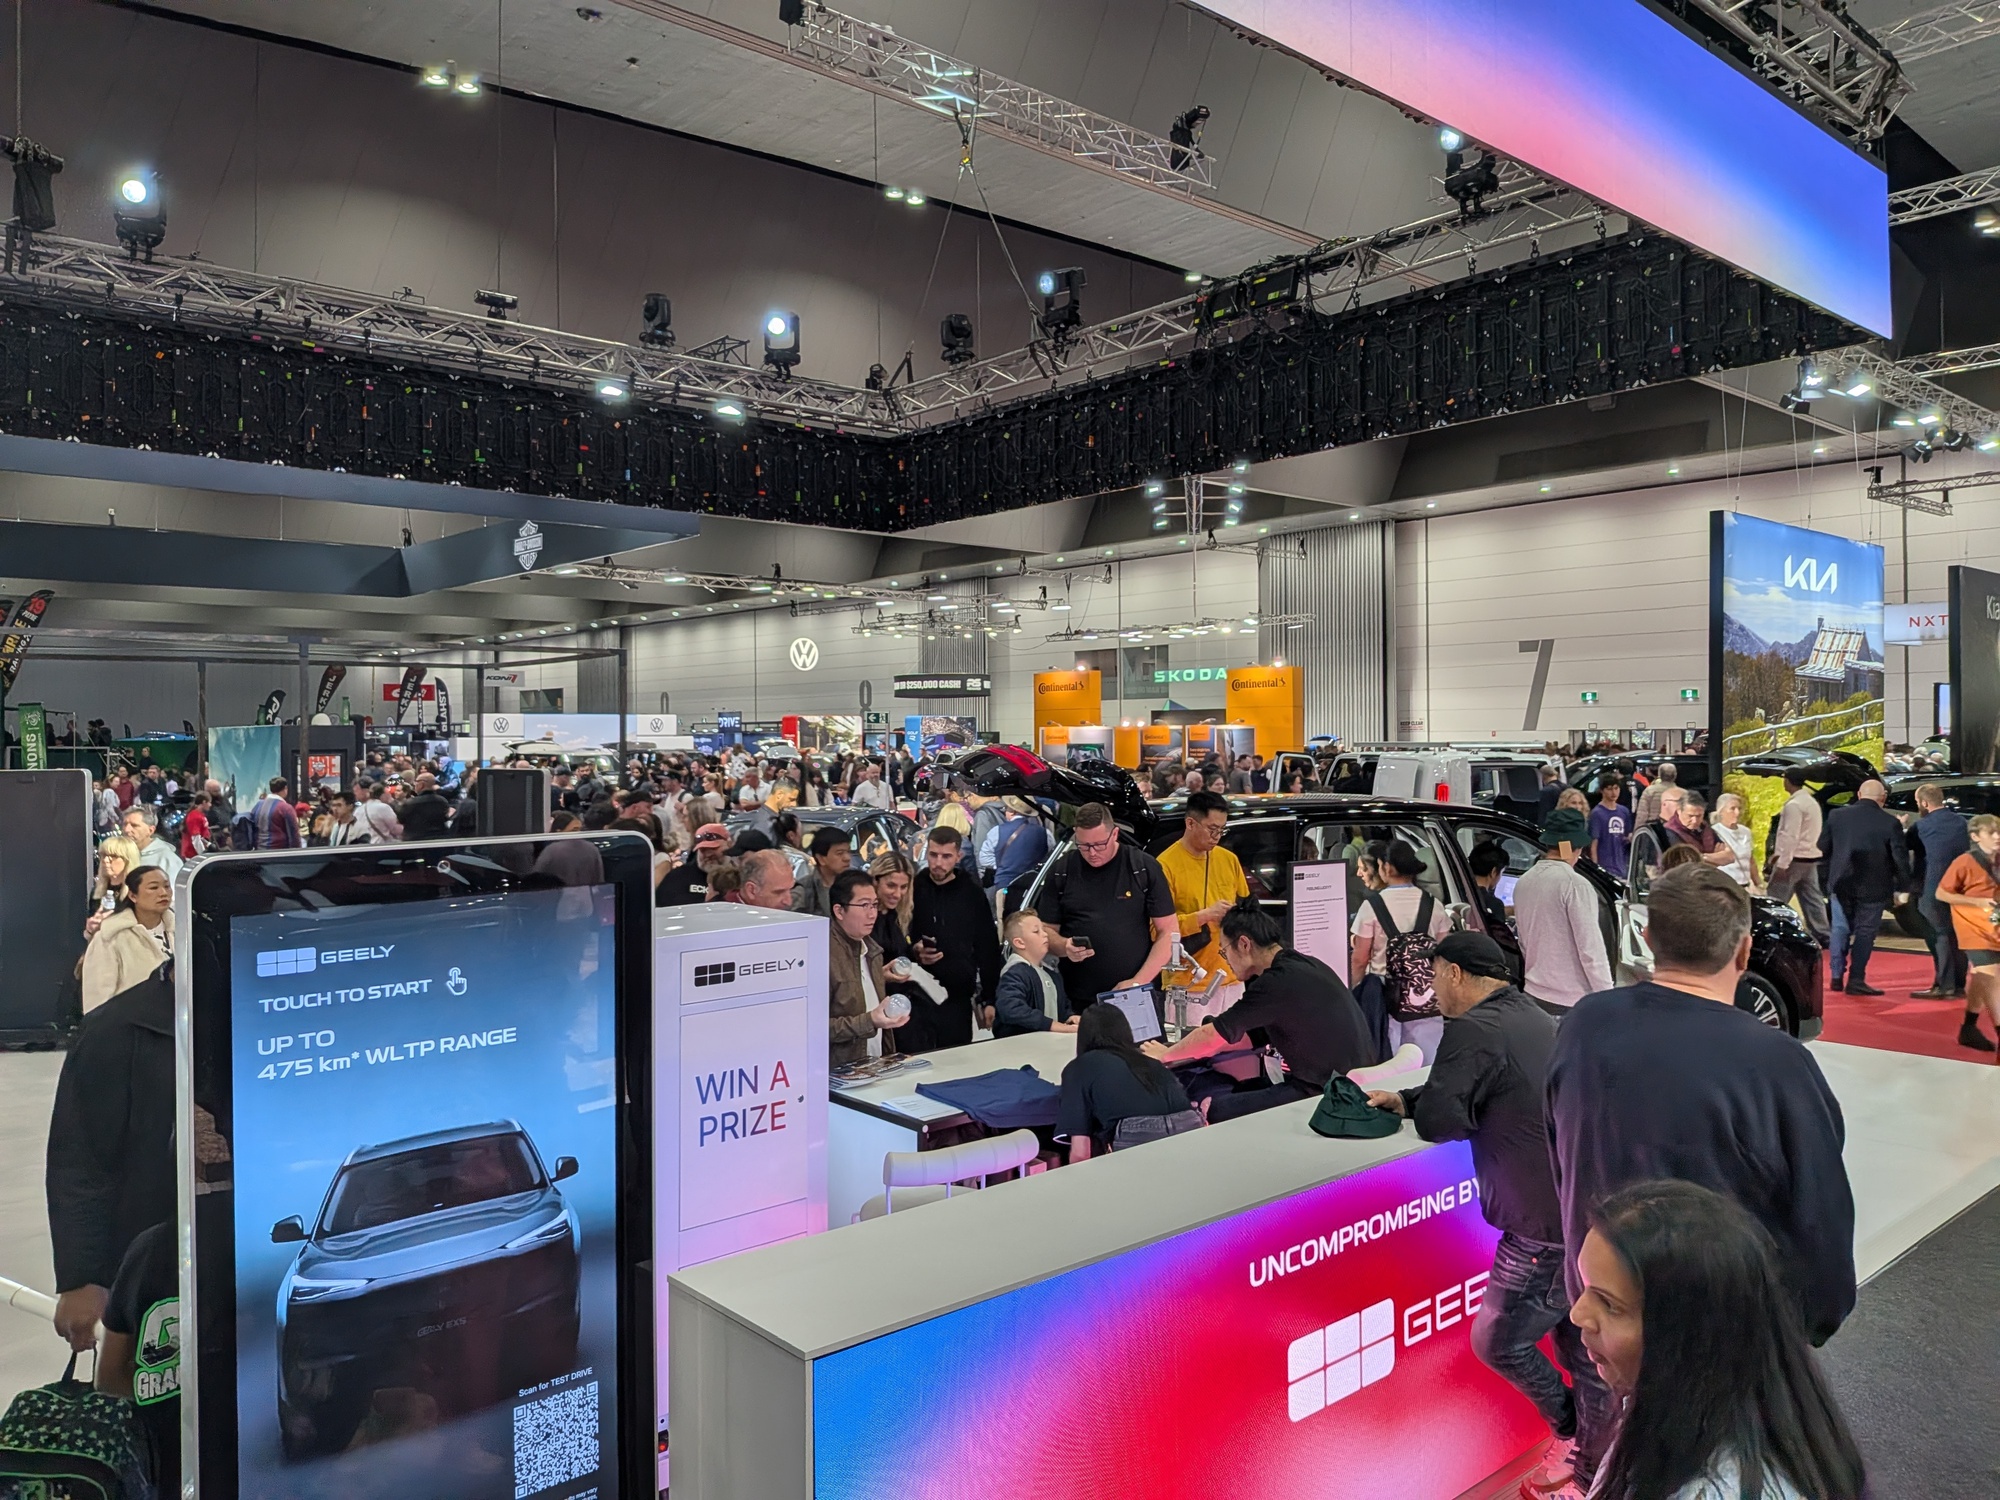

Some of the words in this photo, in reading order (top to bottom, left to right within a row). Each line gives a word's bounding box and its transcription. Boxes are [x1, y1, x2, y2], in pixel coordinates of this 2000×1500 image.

[1784, 554, 1838, 595] KIA
[316, 676, 336, 712] JERKY
[400, 676, 417, 714] JERKY
[938, 680, 962, 689] CASH!
[1038, 681, 1078, 695] Continental
[1231, 678, 1278, 692] Continental
[1518, 639, 1554, 731] 7
[320, 945, 396, 965] GEELY
[738, 958, 796, 976] GEELY
[259, 991, 332, 1013] TOUCH
[335, 987, 365, 1004] TO
[368, 979, 432, 1000] START
[257, 1036, 293, 1056] UP
[298, 1029, 336, 1050] TO
[257, 1057, 313, 1080] 475
[365, 1040, 436, 1065] WLTP
[440, 1027, 517, 1052] RANGE
[695, 1065, 759, 1105] WIN
[769, 1060, 790, 1091] A
[699, 1099, 786, 1148] PRIZE
[1249, 1186, 1455, 1288] UNCOMPROMISING
[518, 1386, 537, 1397] Scan
[538, 1382, 549, 1391] for
[551, 1374, 570, 1387] TEST
[571, 1367, 593, 1380] DRIVE
